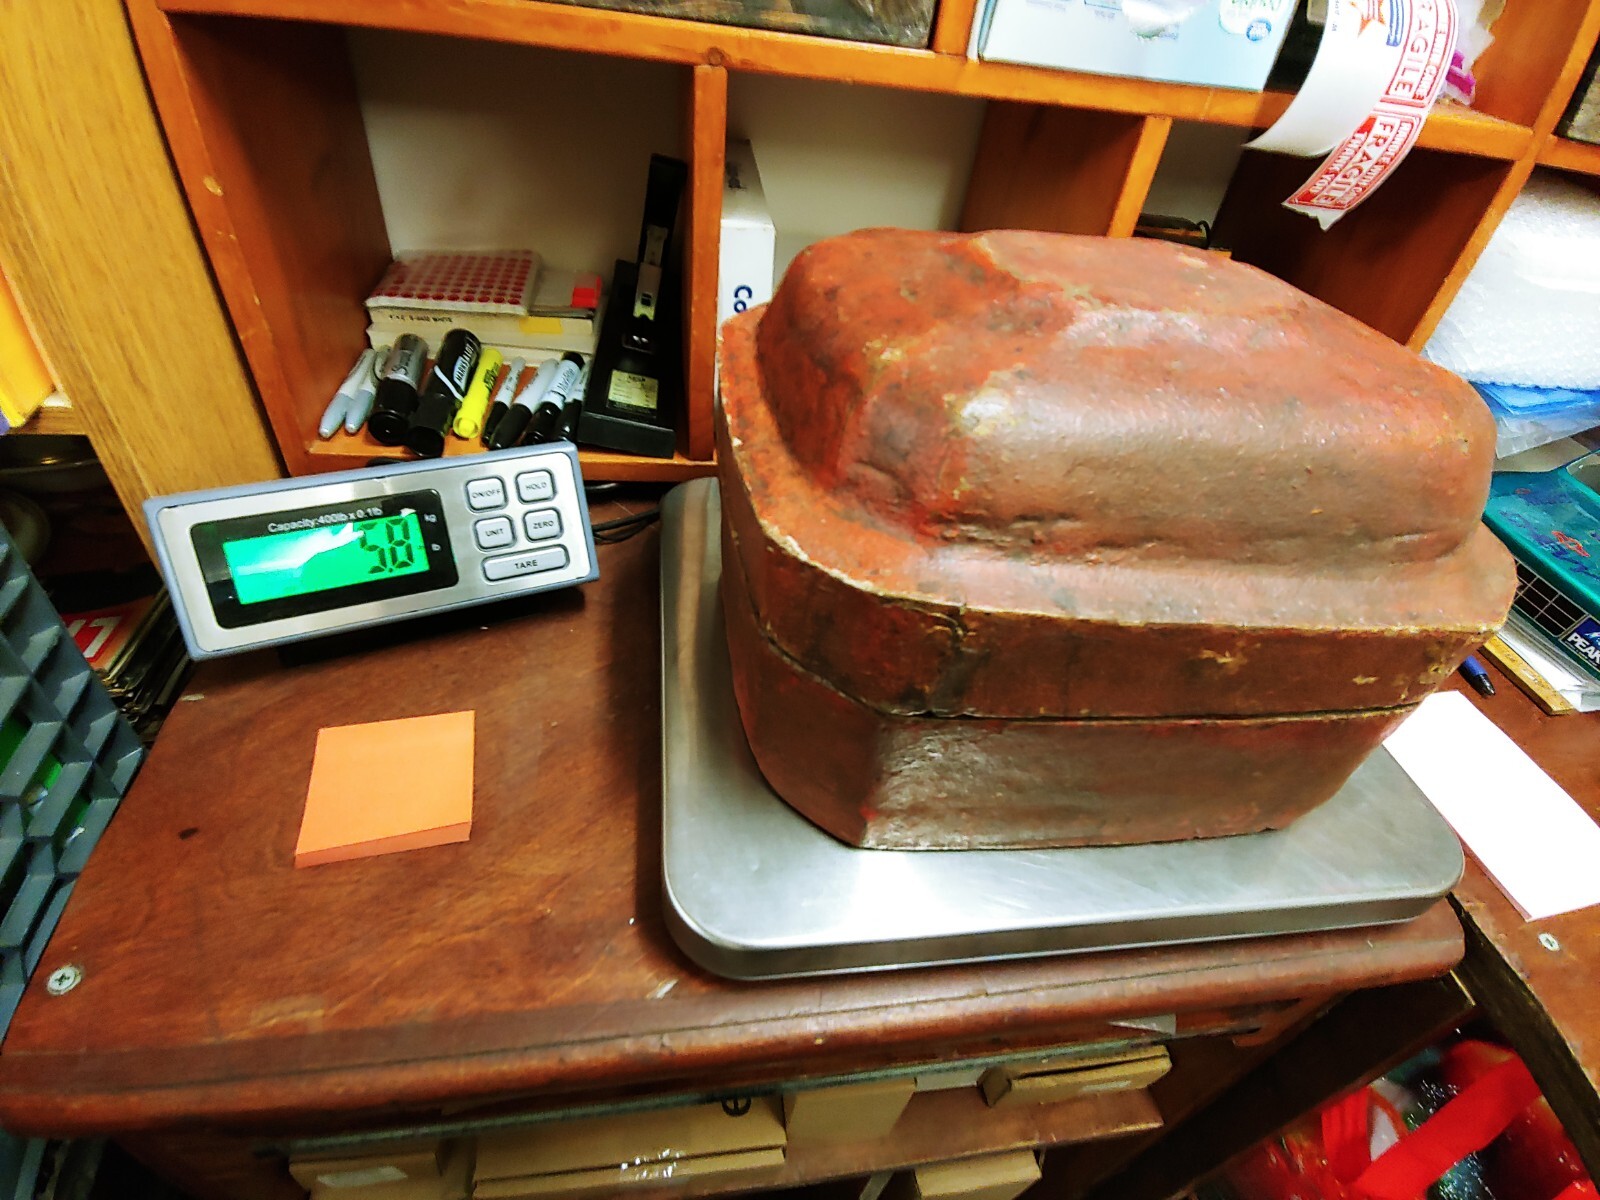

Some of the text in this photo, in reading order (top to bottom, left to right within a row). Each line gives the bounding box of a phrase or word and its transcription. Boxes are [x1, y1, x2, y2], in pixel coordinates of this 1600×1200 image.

[1309, 131, 1368, 193] THANK YOU
[1312, 122, 1395, 204] FRAGILE
[454, 359, 467, 382] MARKS
[526, 482, 547, 490] HOLD
[472, 489, 501, 498] ON/OFF
[533, 520, 554, 529] ZERO
[485, 528, 503, 537] UNIT
[515, 560, 538, 569] TARE
